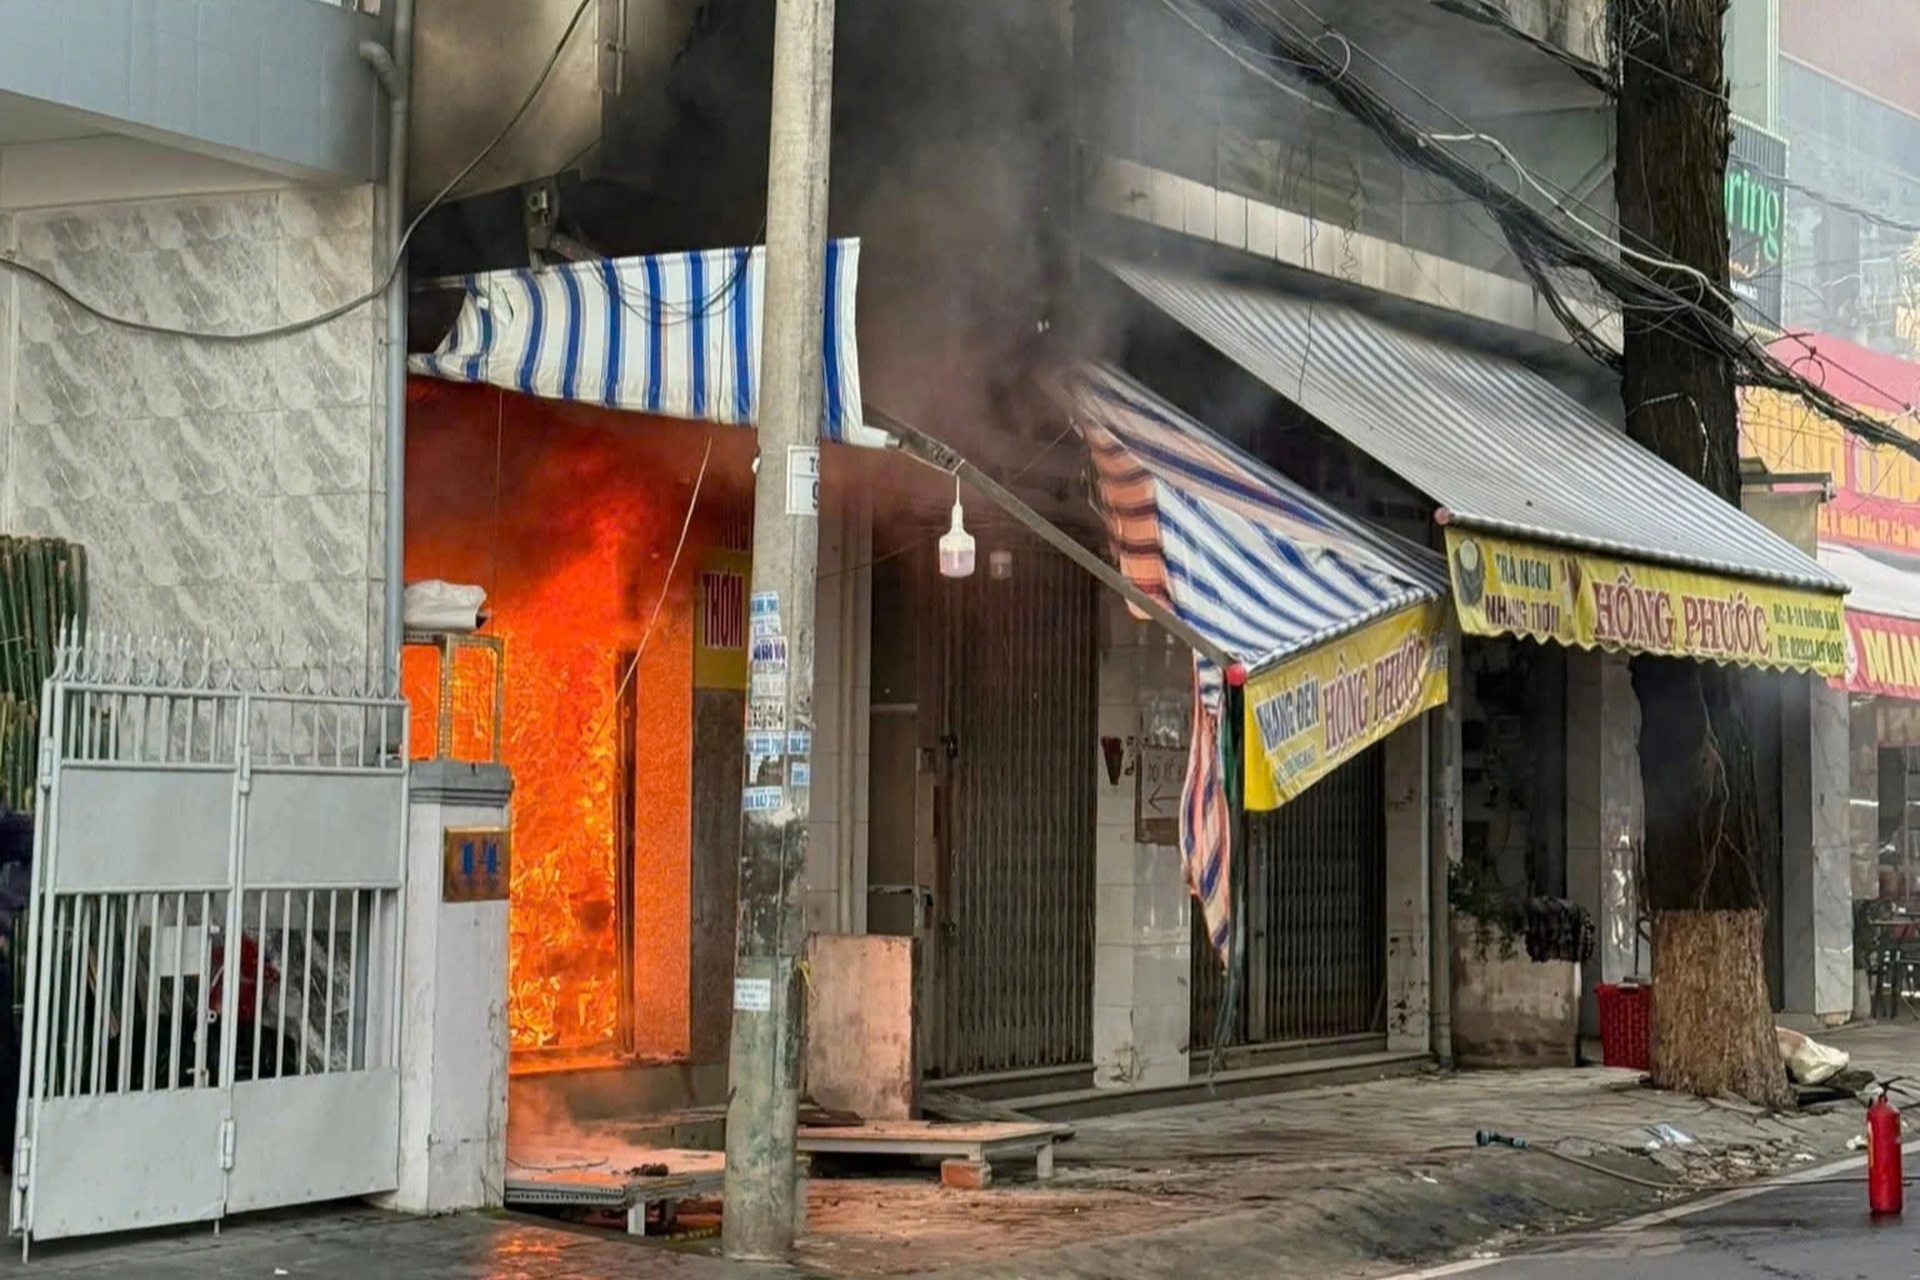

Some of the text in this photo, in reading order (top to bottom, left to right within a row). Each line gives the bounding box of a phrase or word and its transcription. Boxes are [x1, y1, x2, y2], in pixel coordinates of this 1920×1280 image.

[1593, 566, 1770, 656] HỒNG PHƯỚC
[1323, 653, 1369, 751] HỒNG
